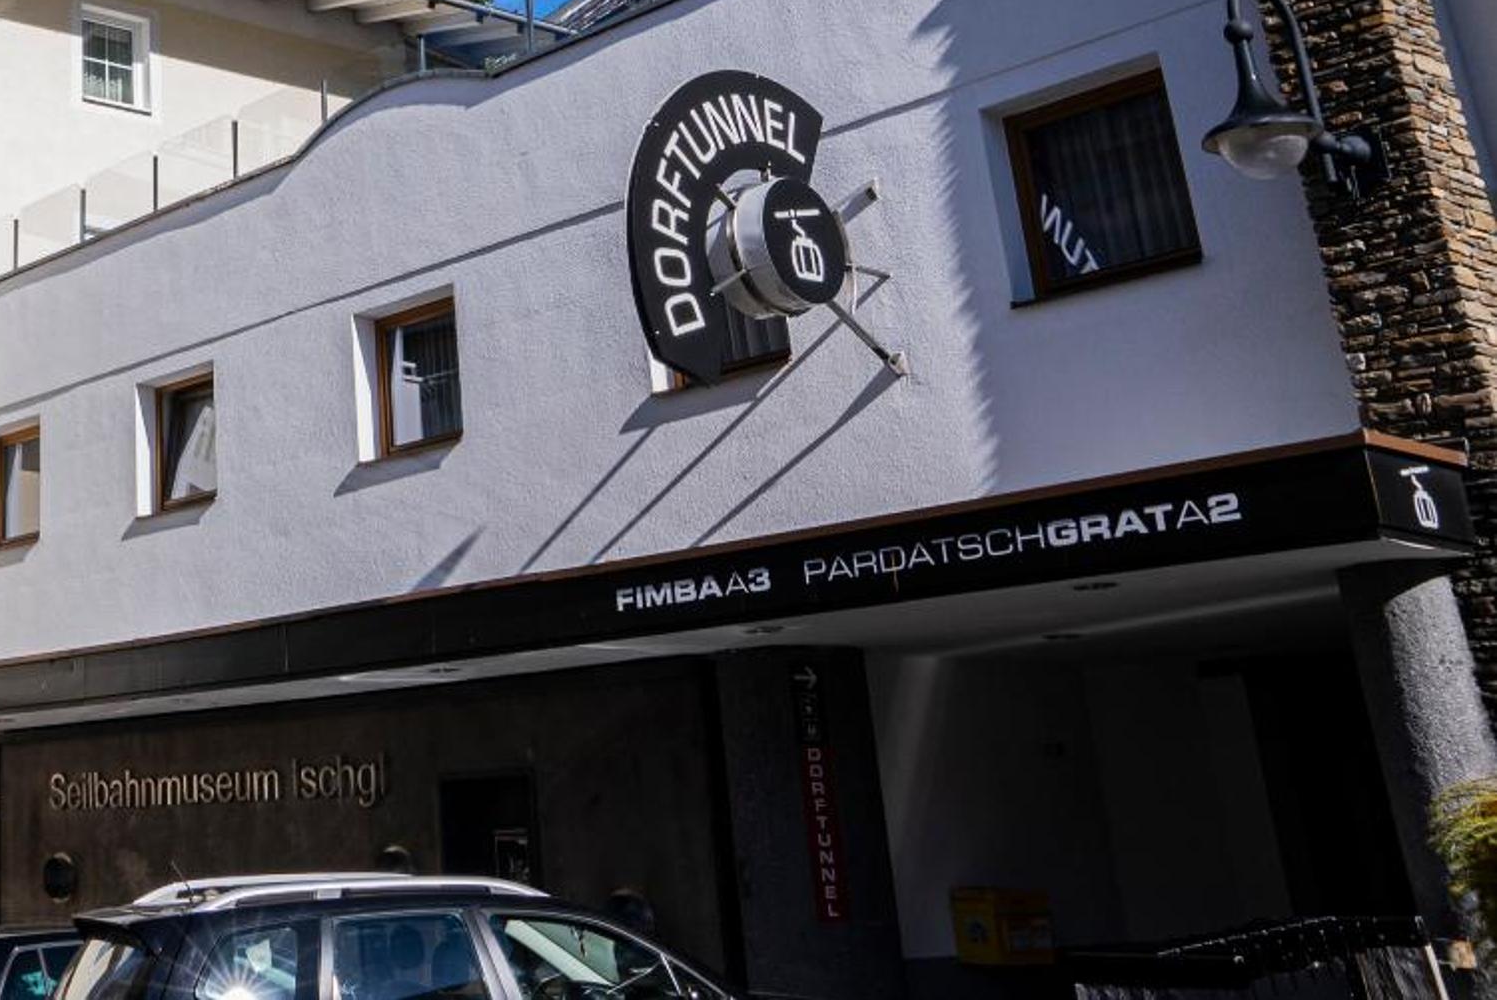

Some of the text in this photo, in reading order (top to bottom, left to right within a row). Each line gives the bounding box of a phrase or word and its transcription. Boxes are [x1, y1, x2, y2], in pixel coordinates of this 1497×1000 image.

[651, 93, 806, 337] DORFTUNNEL
[50, 754, 385, 810] Seilbahnmuseum Ischgl
